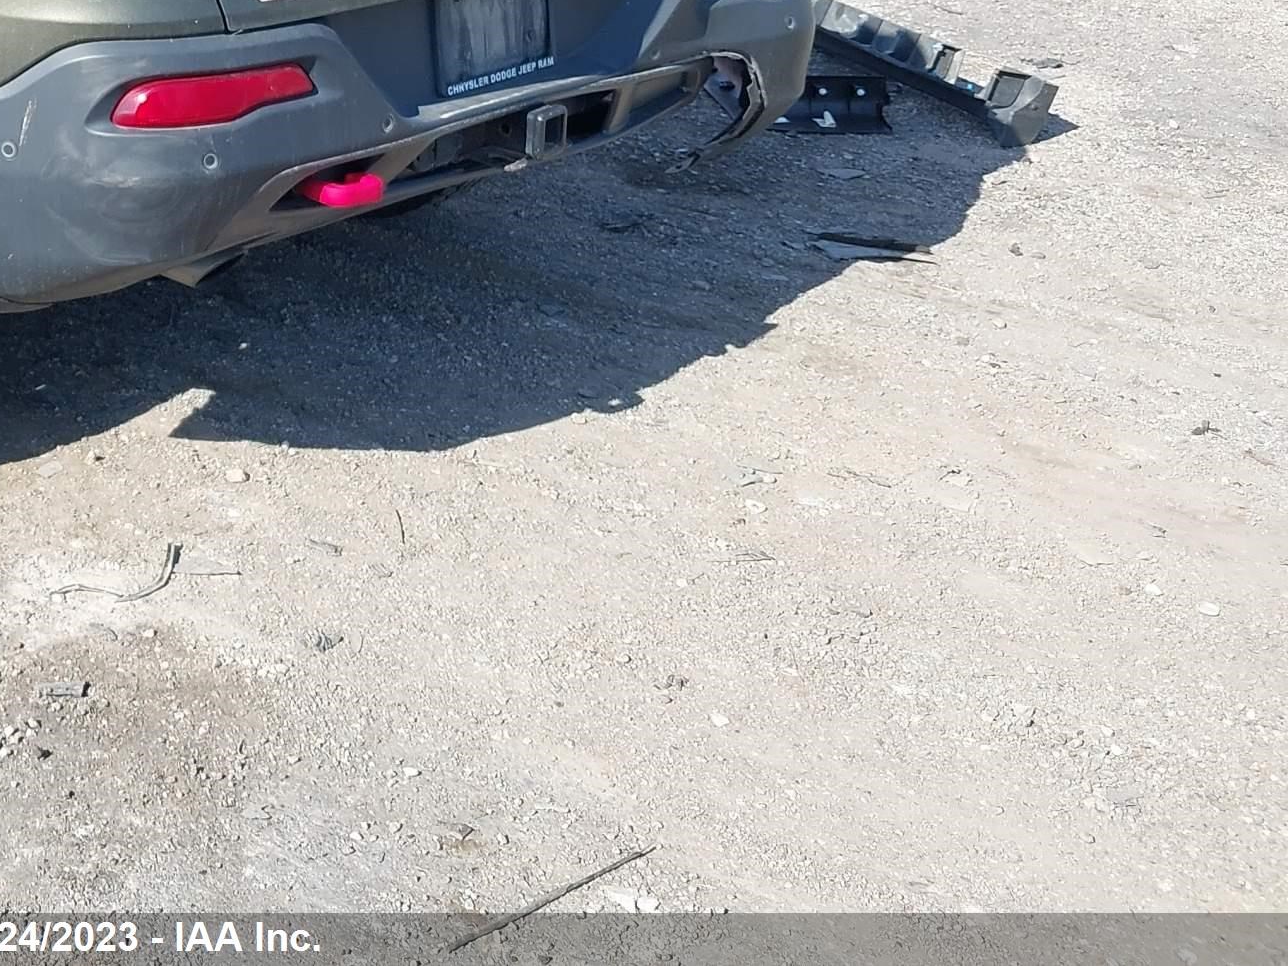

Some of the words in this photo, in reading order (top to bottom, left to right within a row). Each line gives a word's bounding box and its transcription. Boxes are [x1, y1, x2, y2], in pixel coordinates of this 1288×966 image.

[447, 75, 489, 96] CHRYSLER
[490, 67, 517, 83] DODGE
[517, 61, 537, 75] JEEP
[537, 56, 555, 69] RAM
